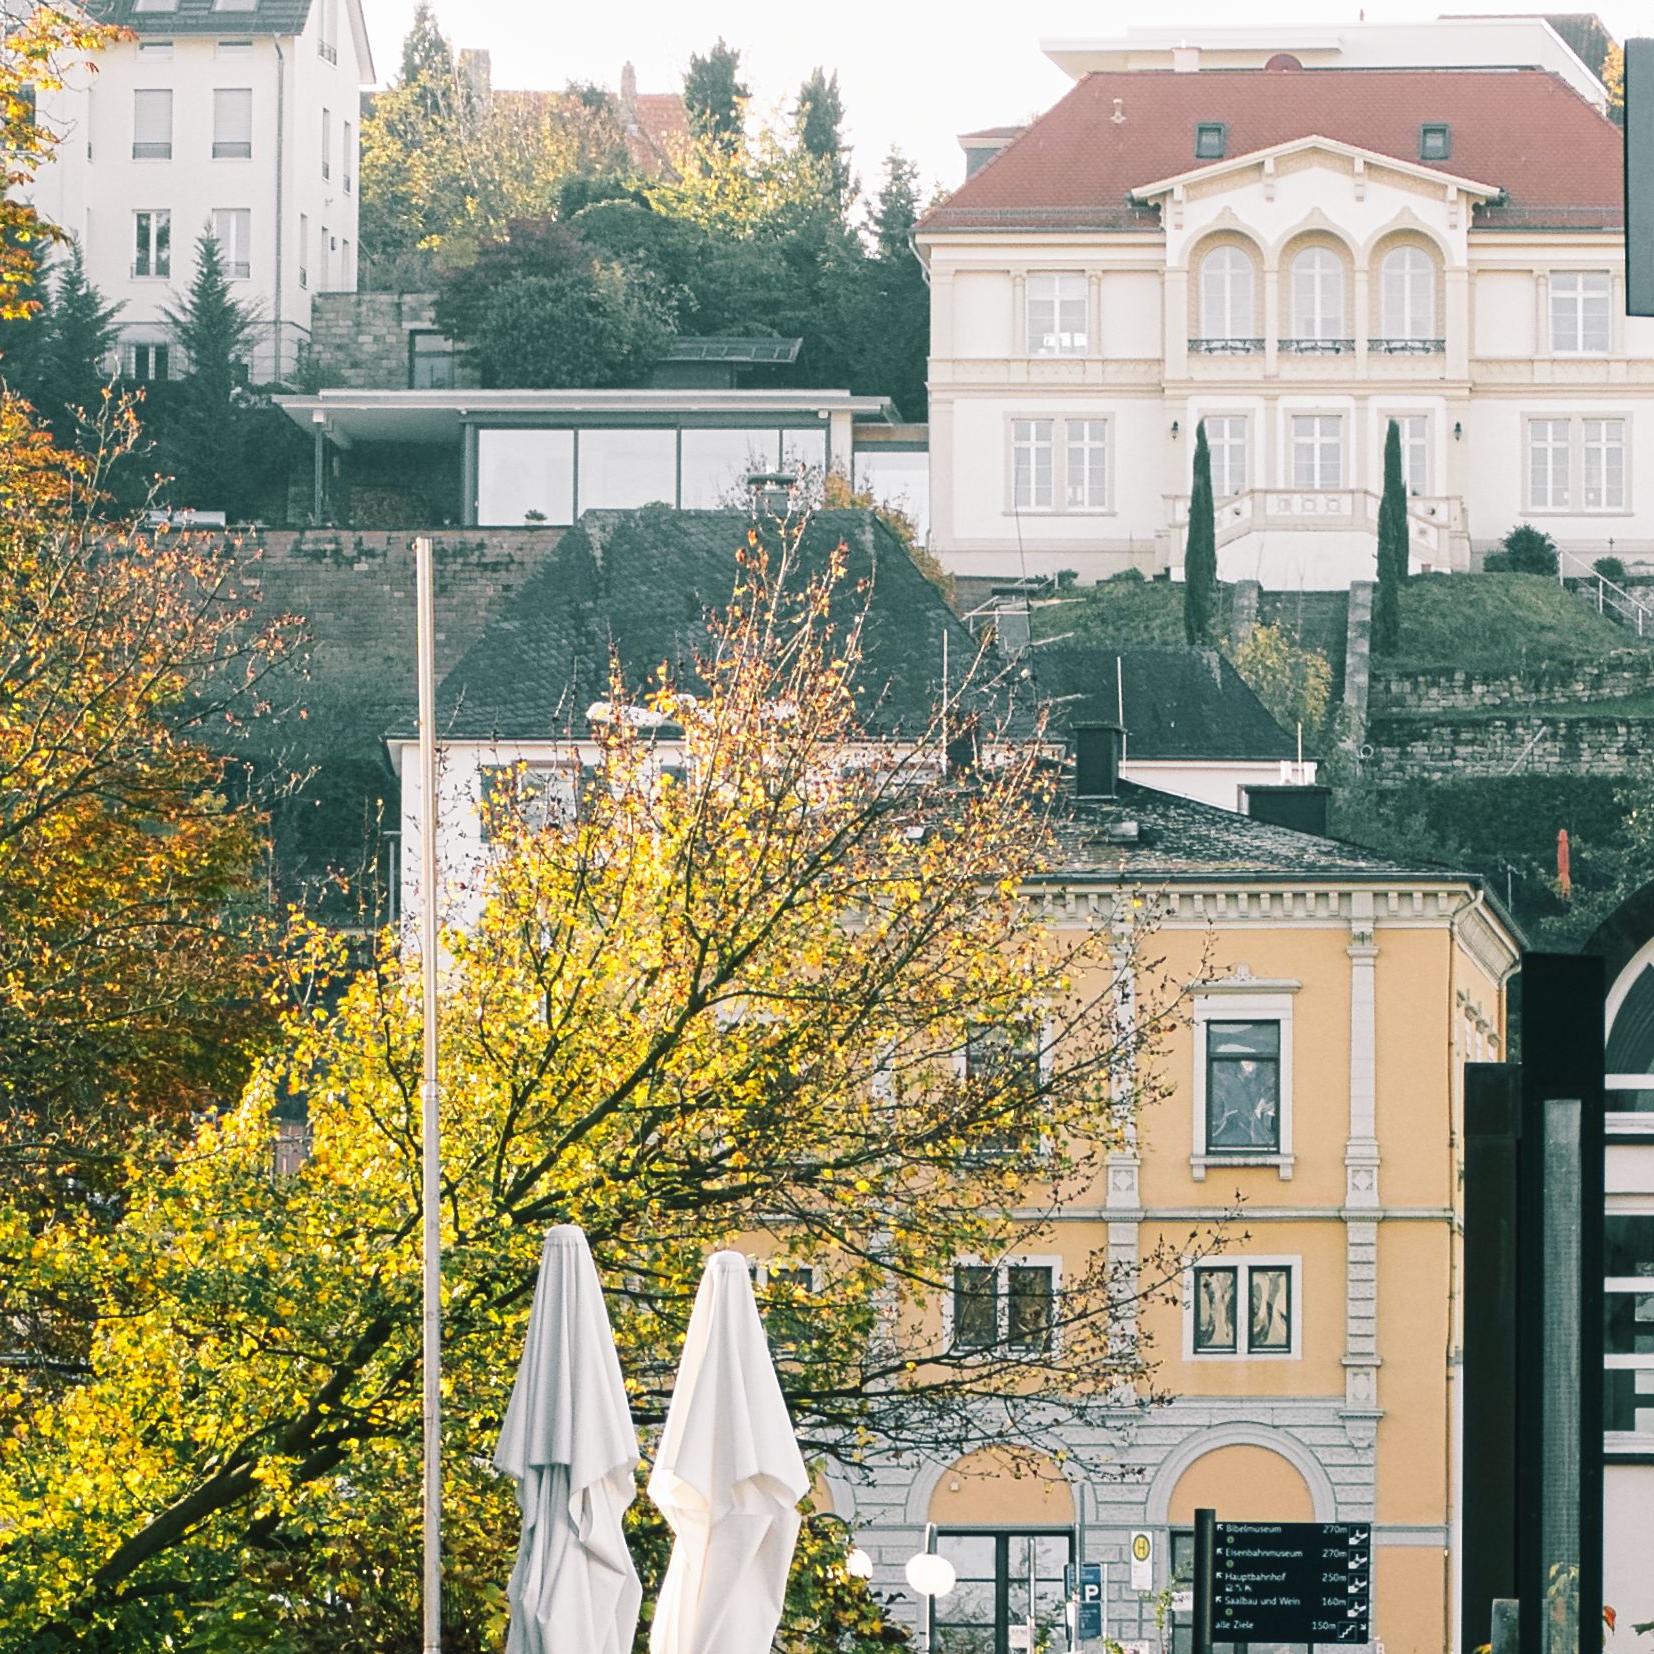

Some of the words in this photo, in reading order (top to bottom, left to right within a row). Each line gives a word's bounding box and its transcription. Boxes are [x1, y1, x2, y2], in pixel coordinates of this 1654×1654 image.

[1226, 1524, 1282, 1533] Bibelmuseum
[1225, 1548, 1303, 1557] Eisenbahnmuseum
[1225, 1572, 1286, 1582] Hauptbahnhof
[1085, 1585, 1099, 1602] P
[1225, 1597, 1258, 1605] Saalbau
[1260, 1597, 1277, 1605] und
[1279, 1597, 1301, 1605] Wein
[1215, 1620, 1231, 1629] alle
[1233, 1621, 1254, 1629] Ziele
